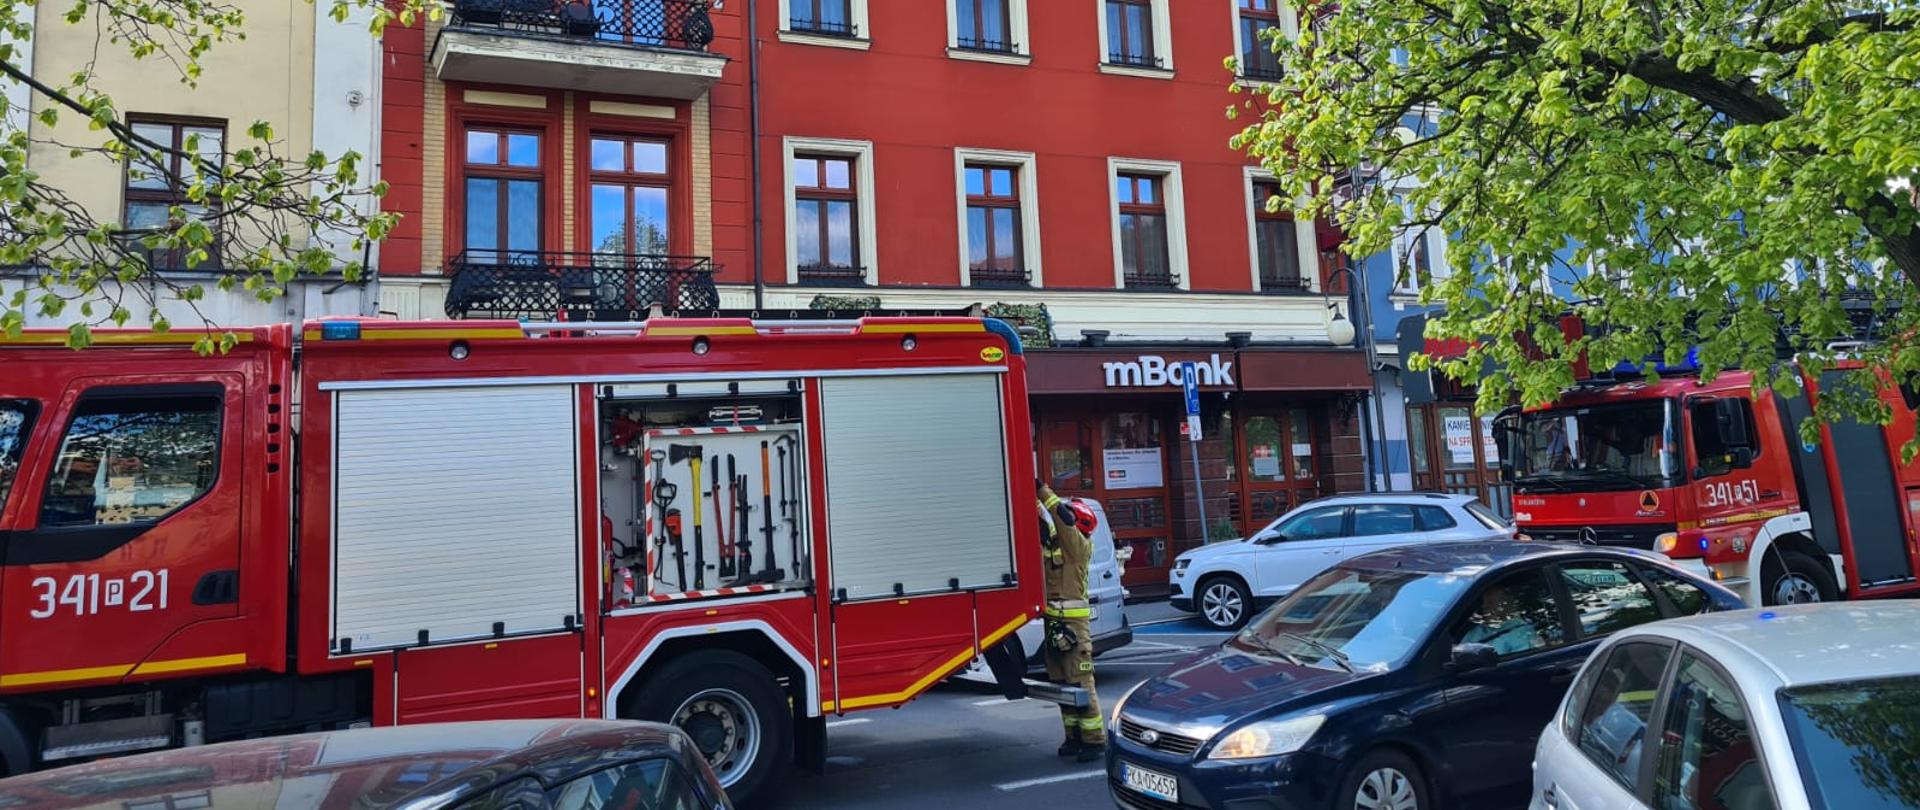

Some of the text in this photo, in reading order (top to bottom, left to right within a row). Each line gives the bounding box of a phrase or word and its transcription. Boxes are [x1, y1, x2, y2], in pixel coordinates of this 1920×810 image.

[1184, 366, 1195, 400] P
[1706, 482, 1734, 507] 341
[1742, 479, 1760, 504] 51
[30, 568, 168, 618] 341 P 21
